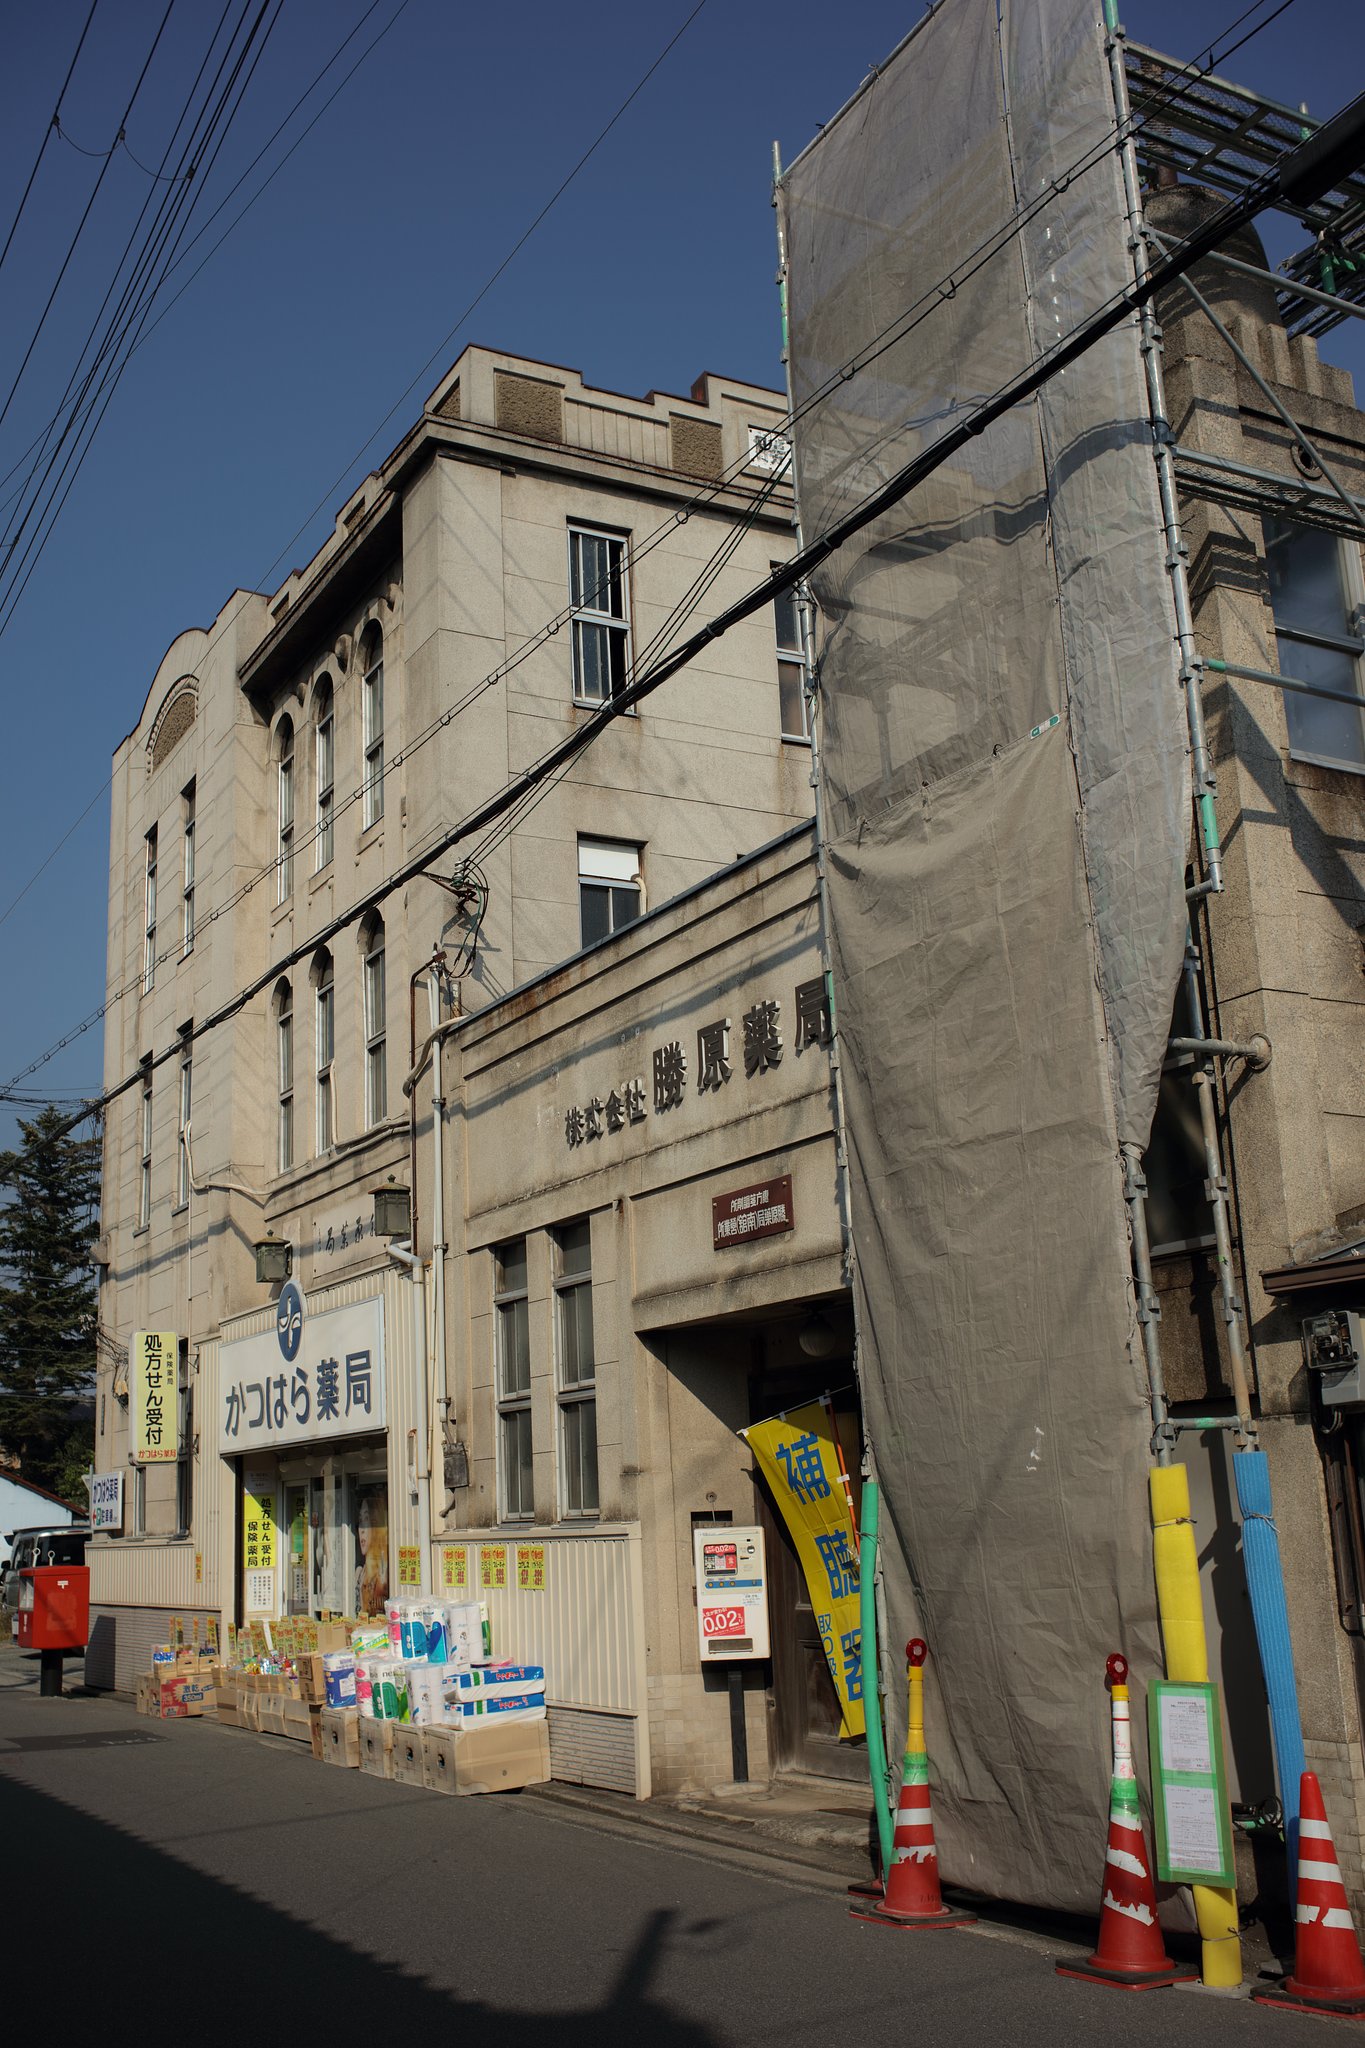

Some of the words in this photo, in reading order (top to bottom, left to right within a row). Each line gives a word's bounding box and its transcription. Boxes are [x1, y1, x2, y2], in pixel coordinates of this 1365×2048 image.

[564, 1078, 648, 1148] 株式会社
[652, 974, 832, 1112] 勝原薬局
[144, 1334, 163, 1446] 処方せん受付
[165, 1351, 174, 1386] 保険薬局
[224, 1349, 371, 1437] かつはら薬局
[137, 1448, 177, 1459] かつはら薬局
[247, 1521, 258, 1567] 保険薬局
[261, 1497, 272, 1567] 処方せん受付
[704, 1611, 739, 1632] 0.02
